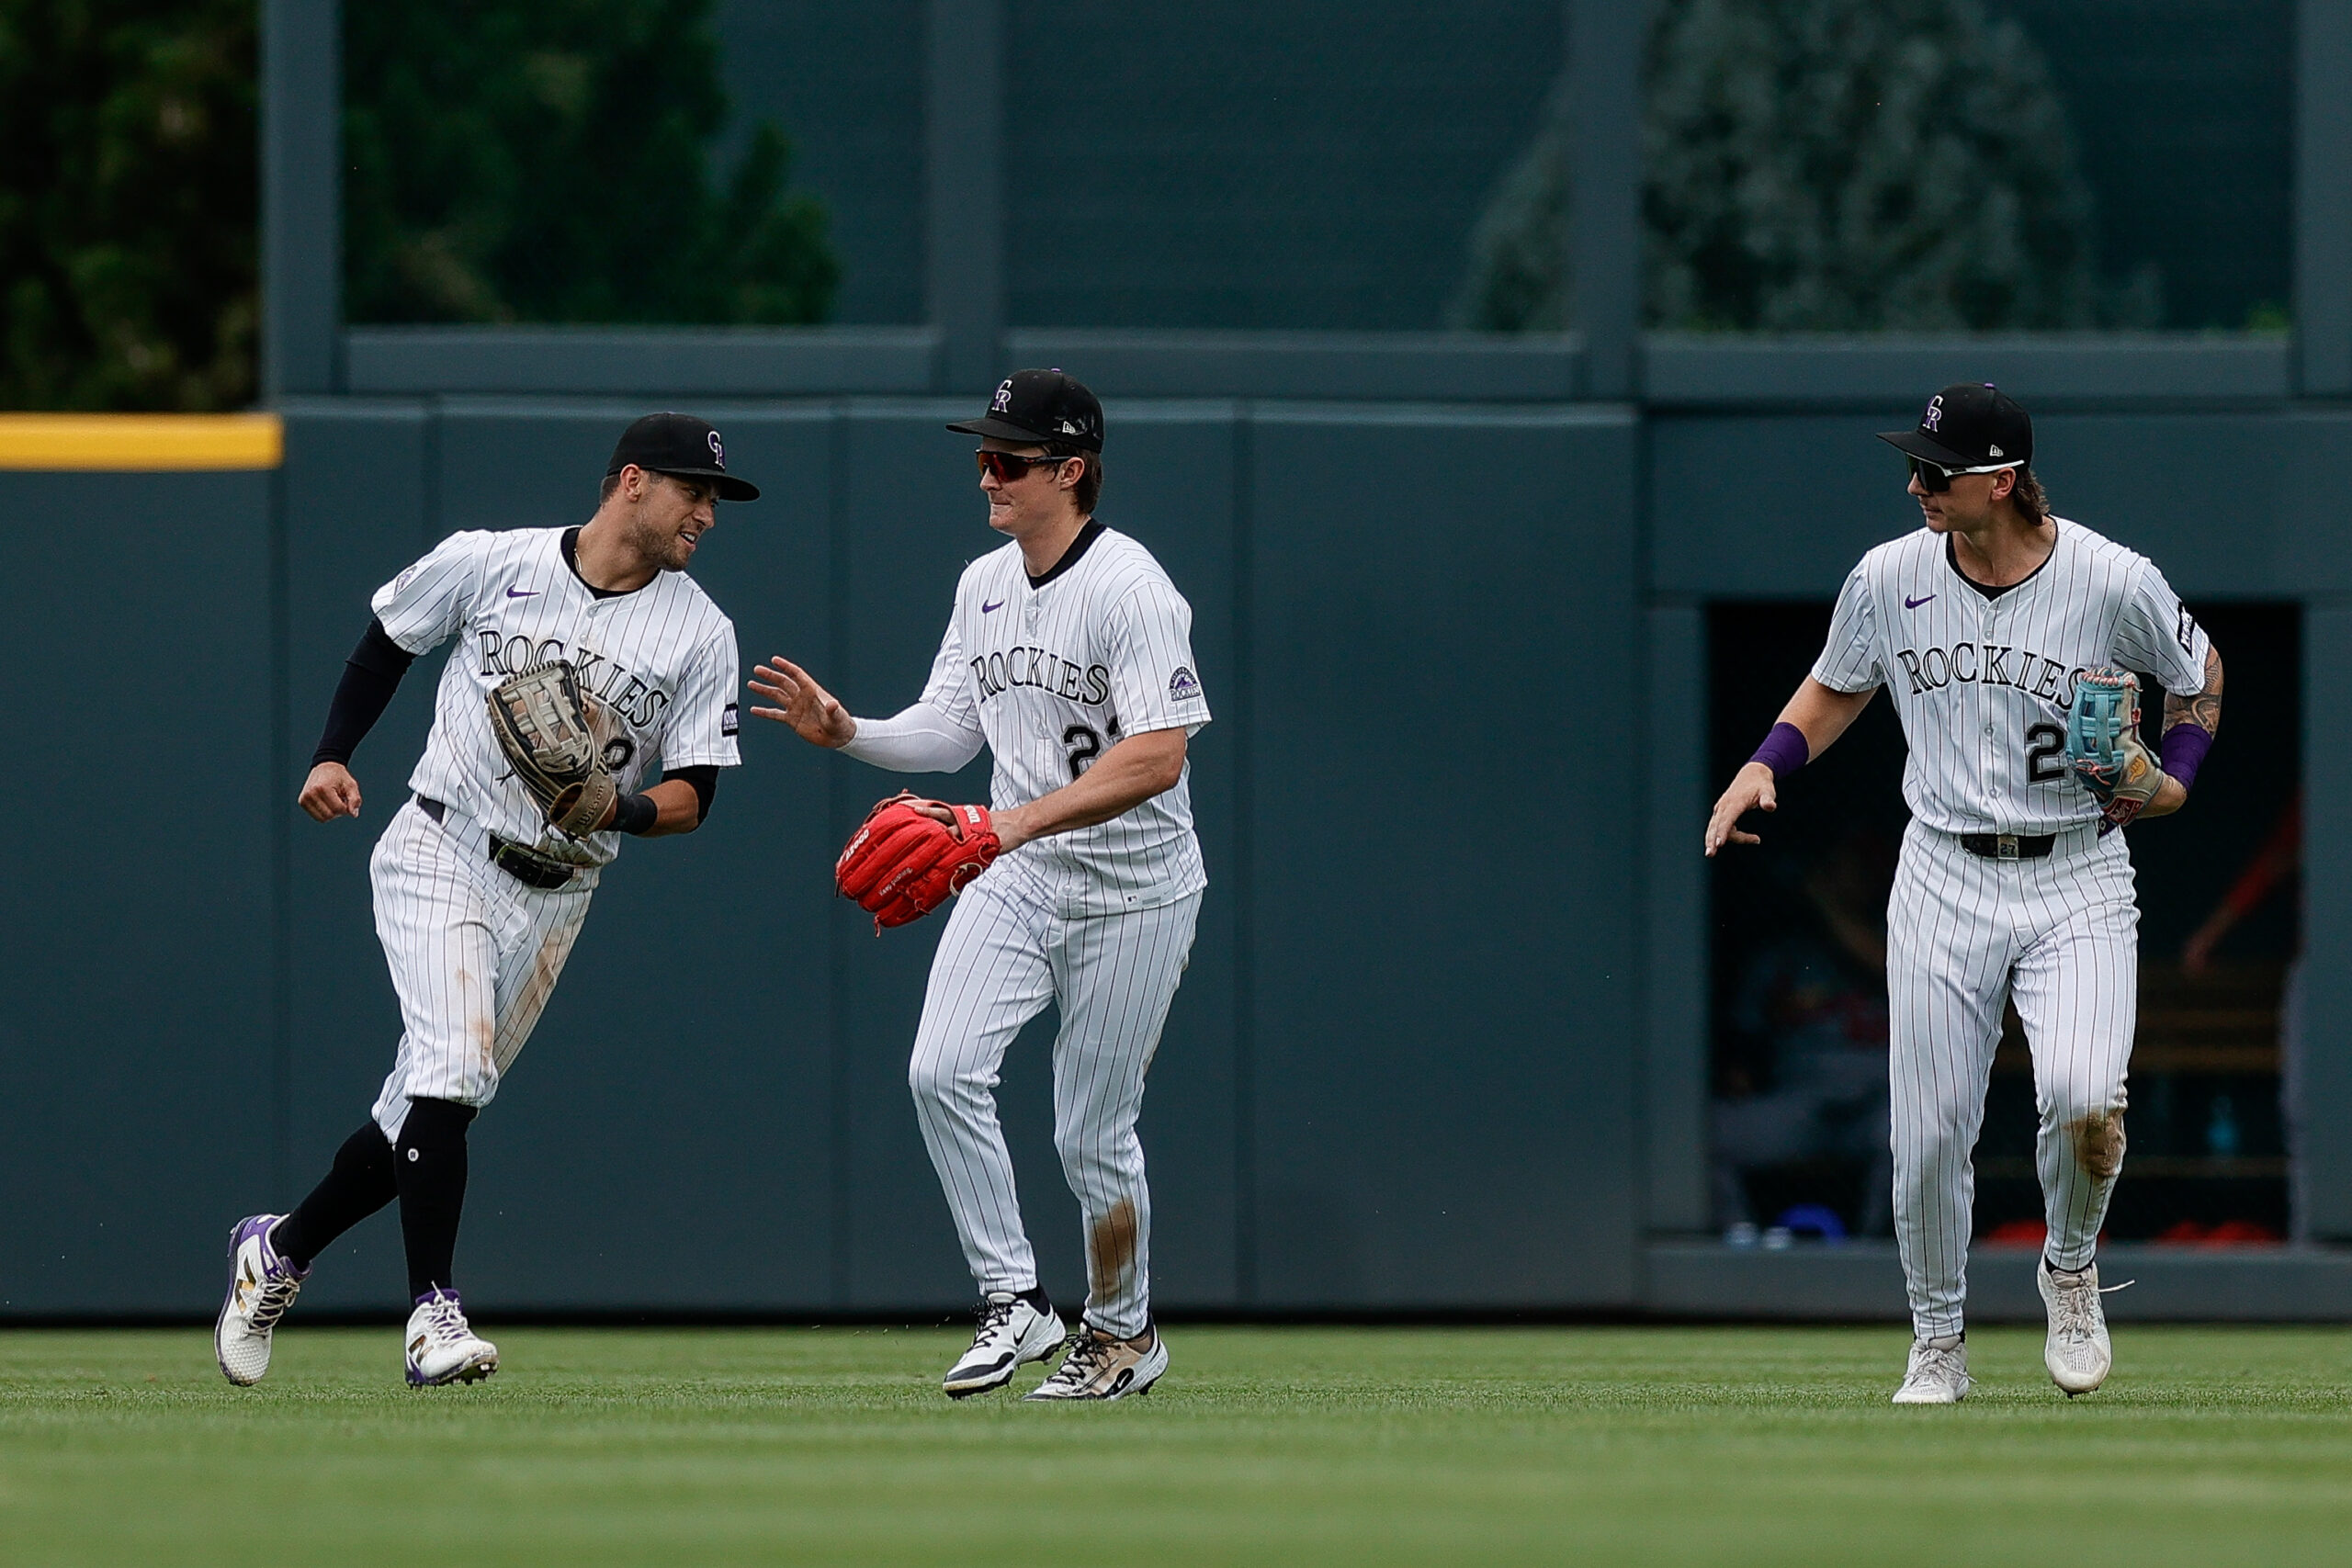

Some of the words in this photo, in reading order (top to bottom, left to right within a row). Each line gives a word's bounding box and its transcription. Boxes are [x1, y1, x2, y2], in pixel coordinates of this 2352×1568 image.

[969, 645, 1110, 706] ROCKIES
[1896, 641, 2087, 711] ROCKIES
[1062, 715, 1122, 781] 2
[576, 784, 604, 826] Wilson
[1999, 843, 2016, 855] 27
